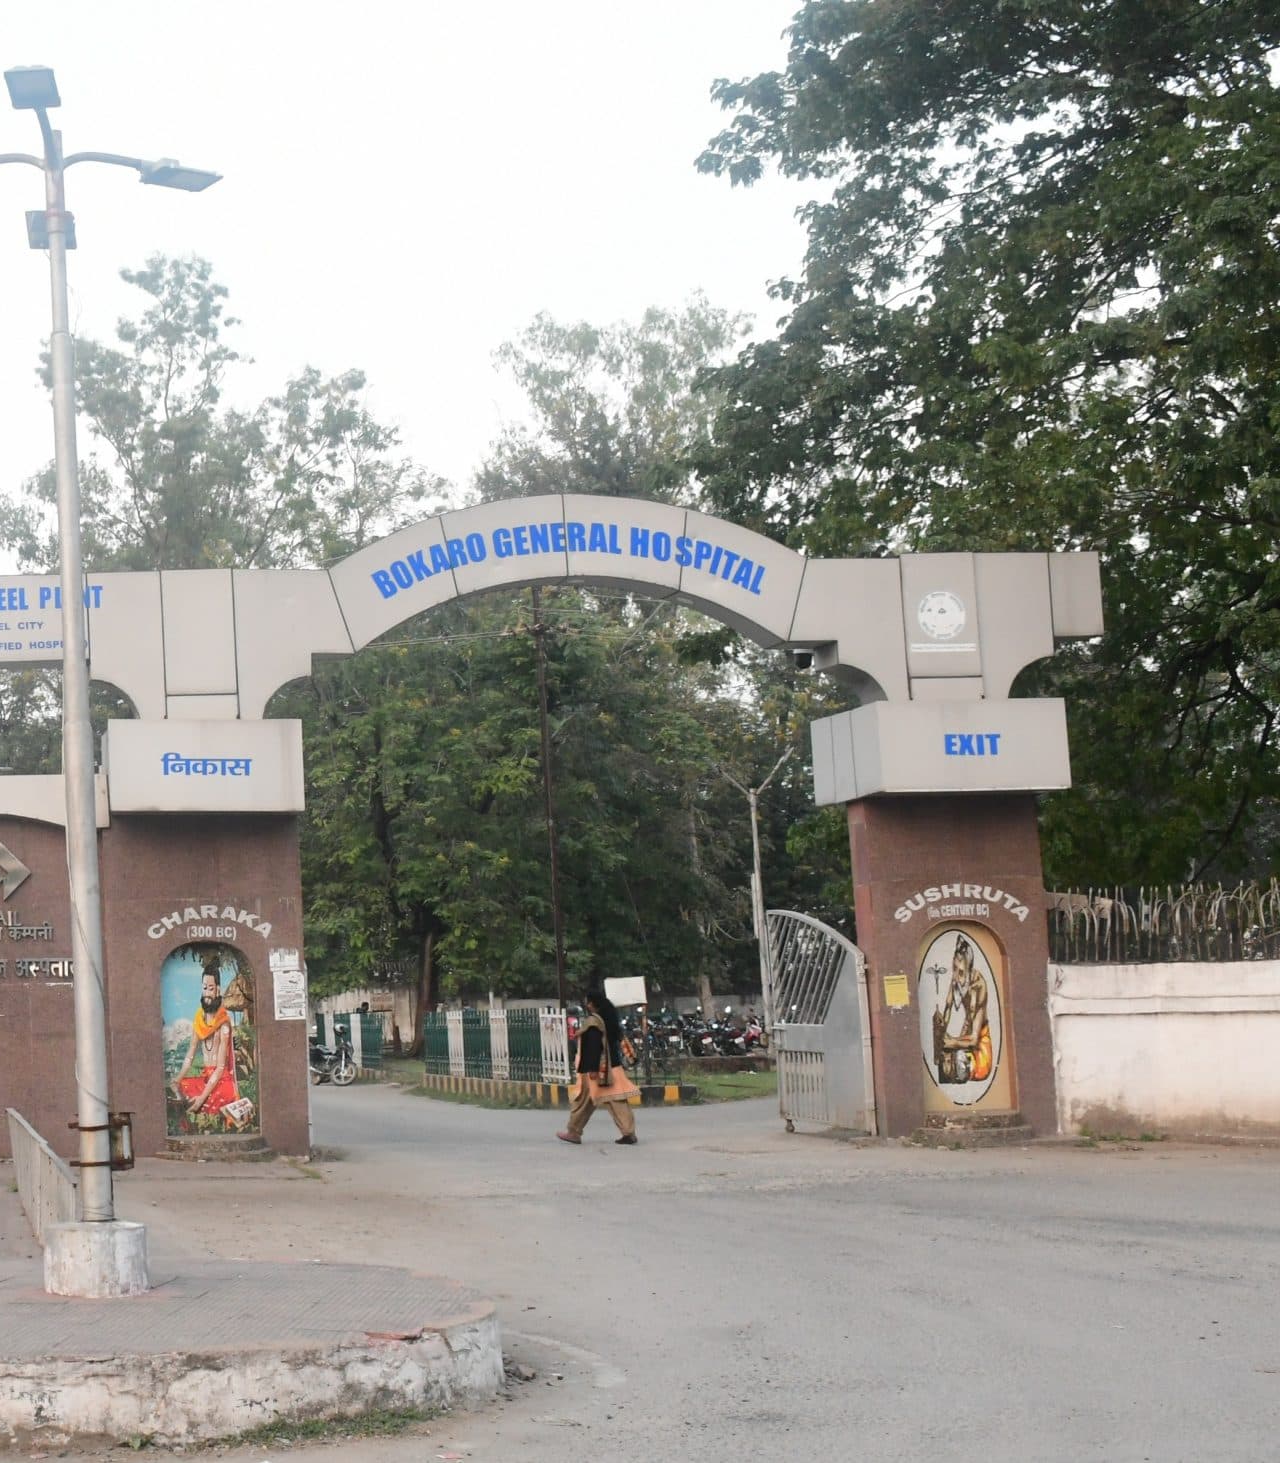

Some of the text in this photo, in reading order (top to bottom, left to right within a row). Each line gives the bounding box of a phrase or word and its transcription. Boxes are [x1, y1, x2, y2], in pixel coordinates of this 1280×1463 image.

[370, 522, 767, 599] BOKARO GENERAL HOSPITAL
[39, 586, 103, 609] PLNT
[17, 621, 44, 630] CITY
[943, 733, 1001, 756] EXIT
[160, 752, 253, 776] निकास
[894, 883, 1030, 923] SUSHRUTA
[147, 904, 272, 939] CHARAKA
[186, 925, 237, 941] (300 BC)
[16, 957, 74, 978] अस्पता
